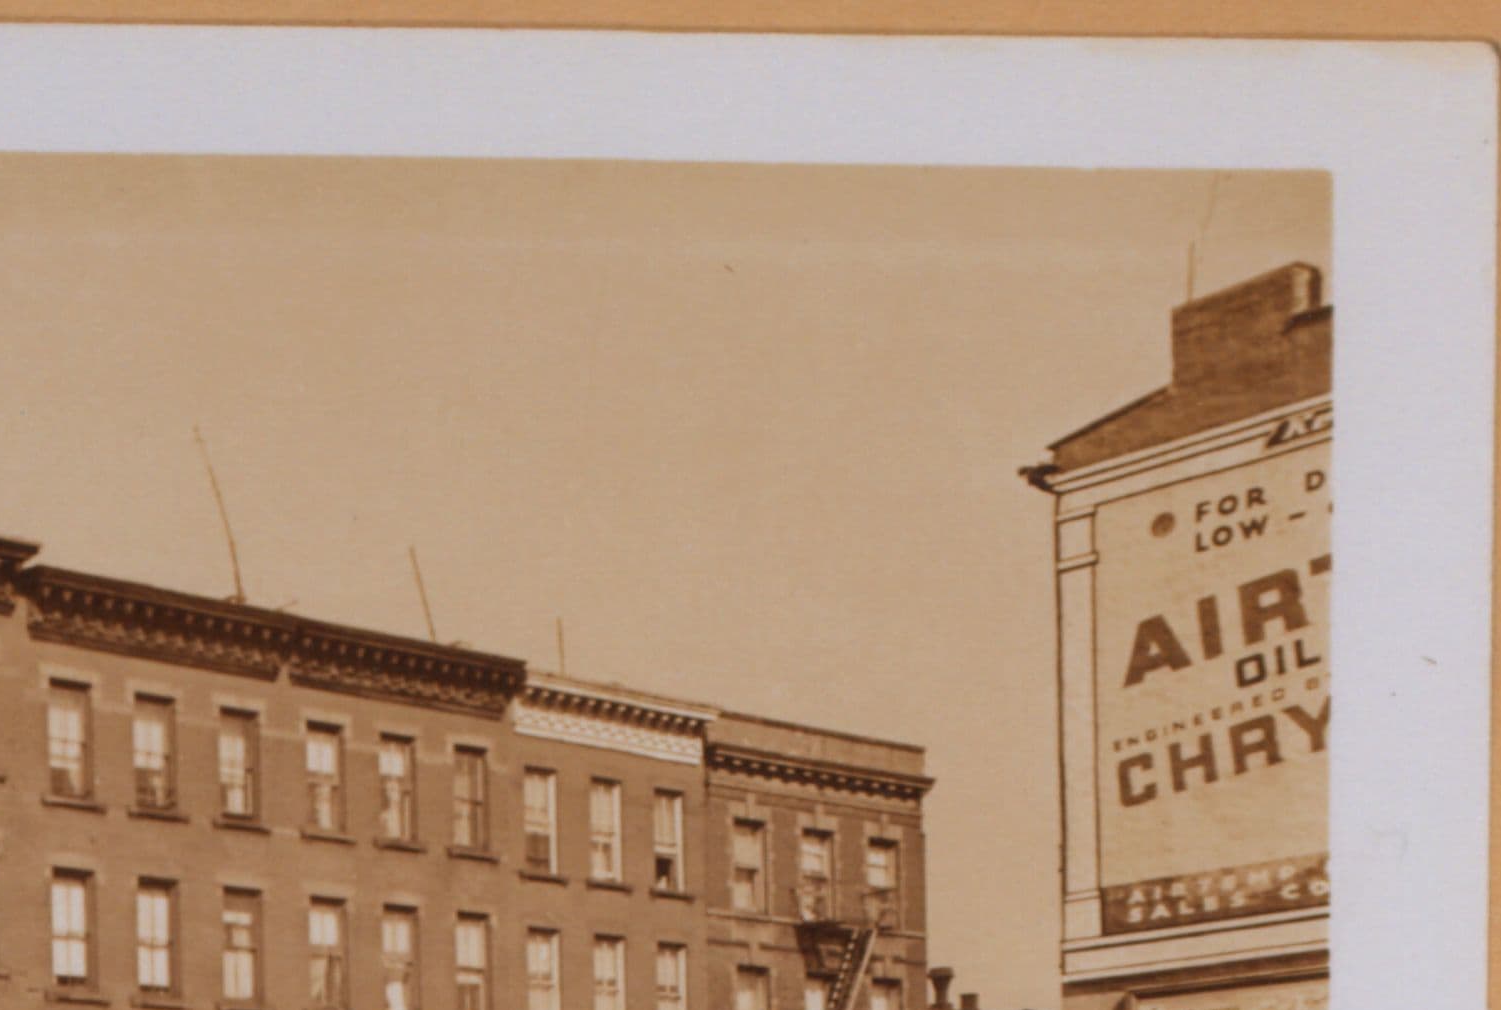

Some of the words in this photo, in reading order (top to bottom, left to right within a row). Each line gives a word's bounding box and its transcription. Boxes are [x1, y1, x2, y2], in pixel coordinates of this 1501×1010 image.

[1195, 487, 1267, 523] FOR
[1235, 639, 1322, 688] OIL
[1113, 687, 1285, 752] ENGINEERED
[1117, 694, 1331, 808] CHRY
[1126, 892, 1248, 923] SALES
